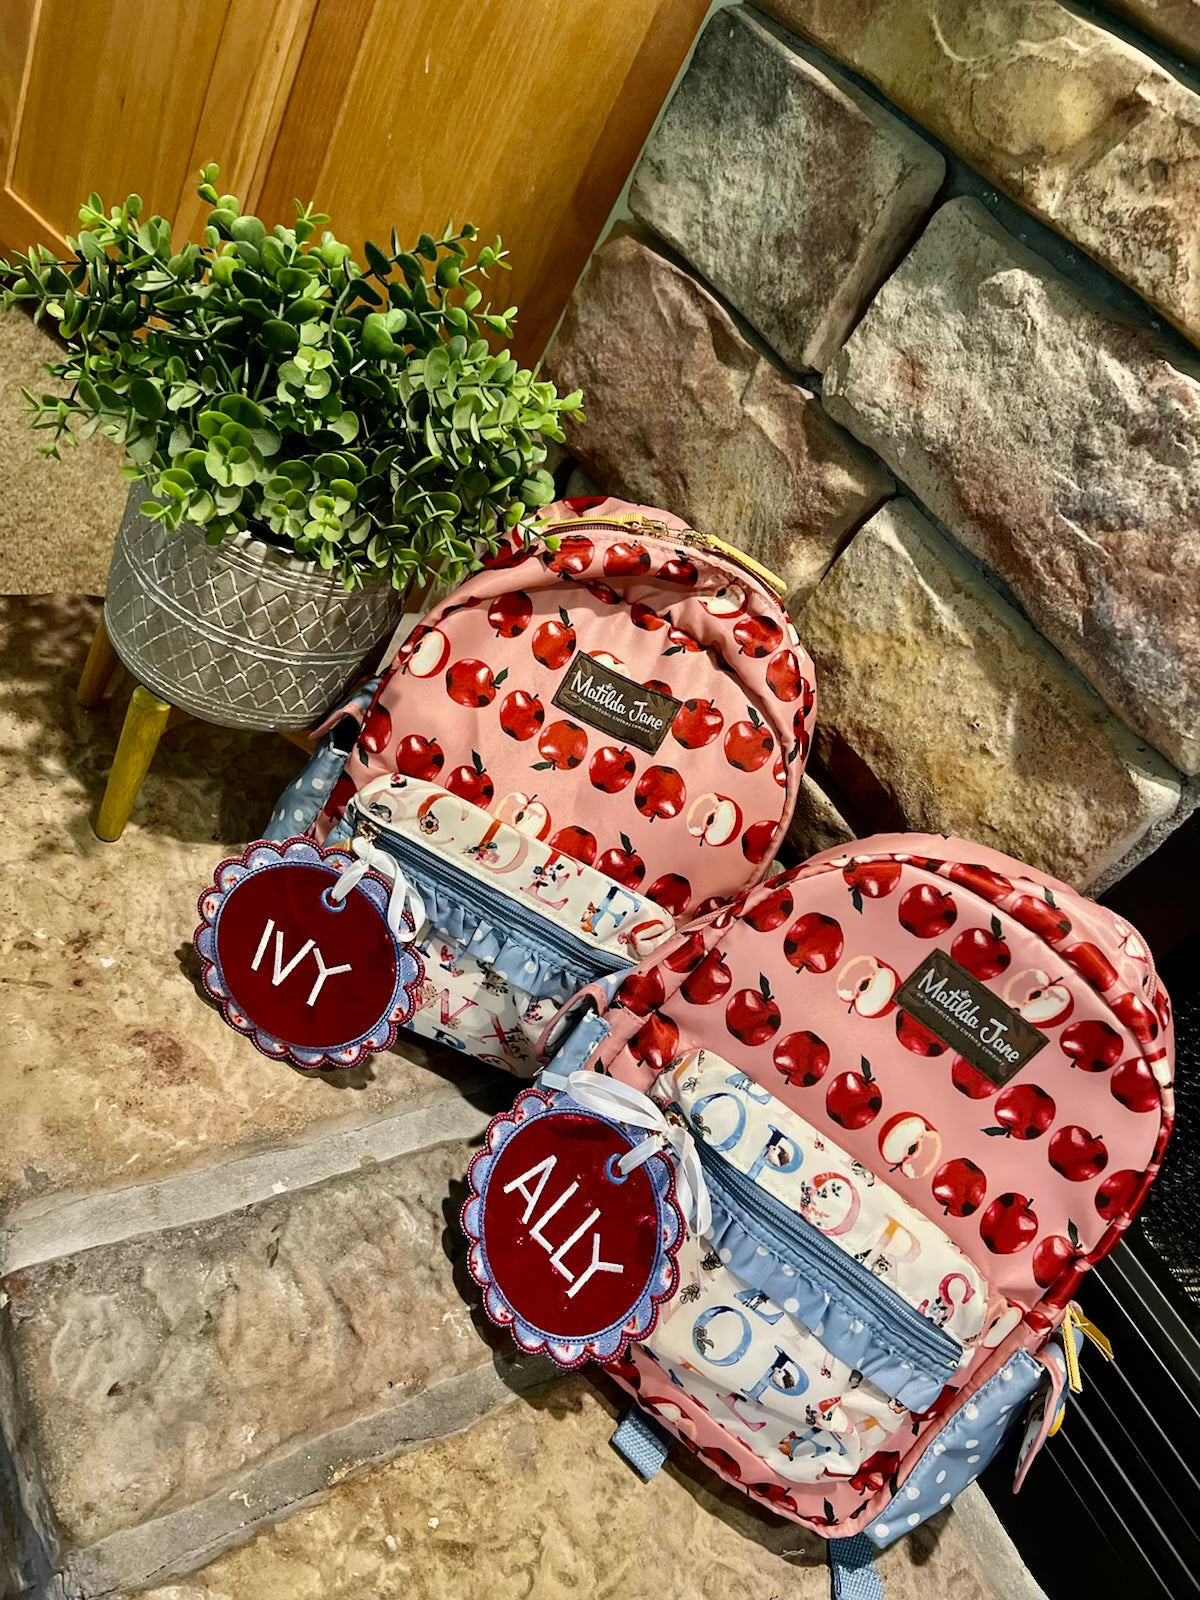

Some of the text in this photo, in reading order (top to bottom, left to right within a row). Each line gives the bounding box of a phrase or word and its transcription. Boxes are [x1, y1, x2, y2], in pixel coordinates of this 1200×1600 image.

[570, 669, 663, 731] Matilda Jane
[251, 918, 353, 1007] IVY
[917, 967, 1020, 1063] Matilda Jane
[503, 1154, 624, 1299] ALLY
